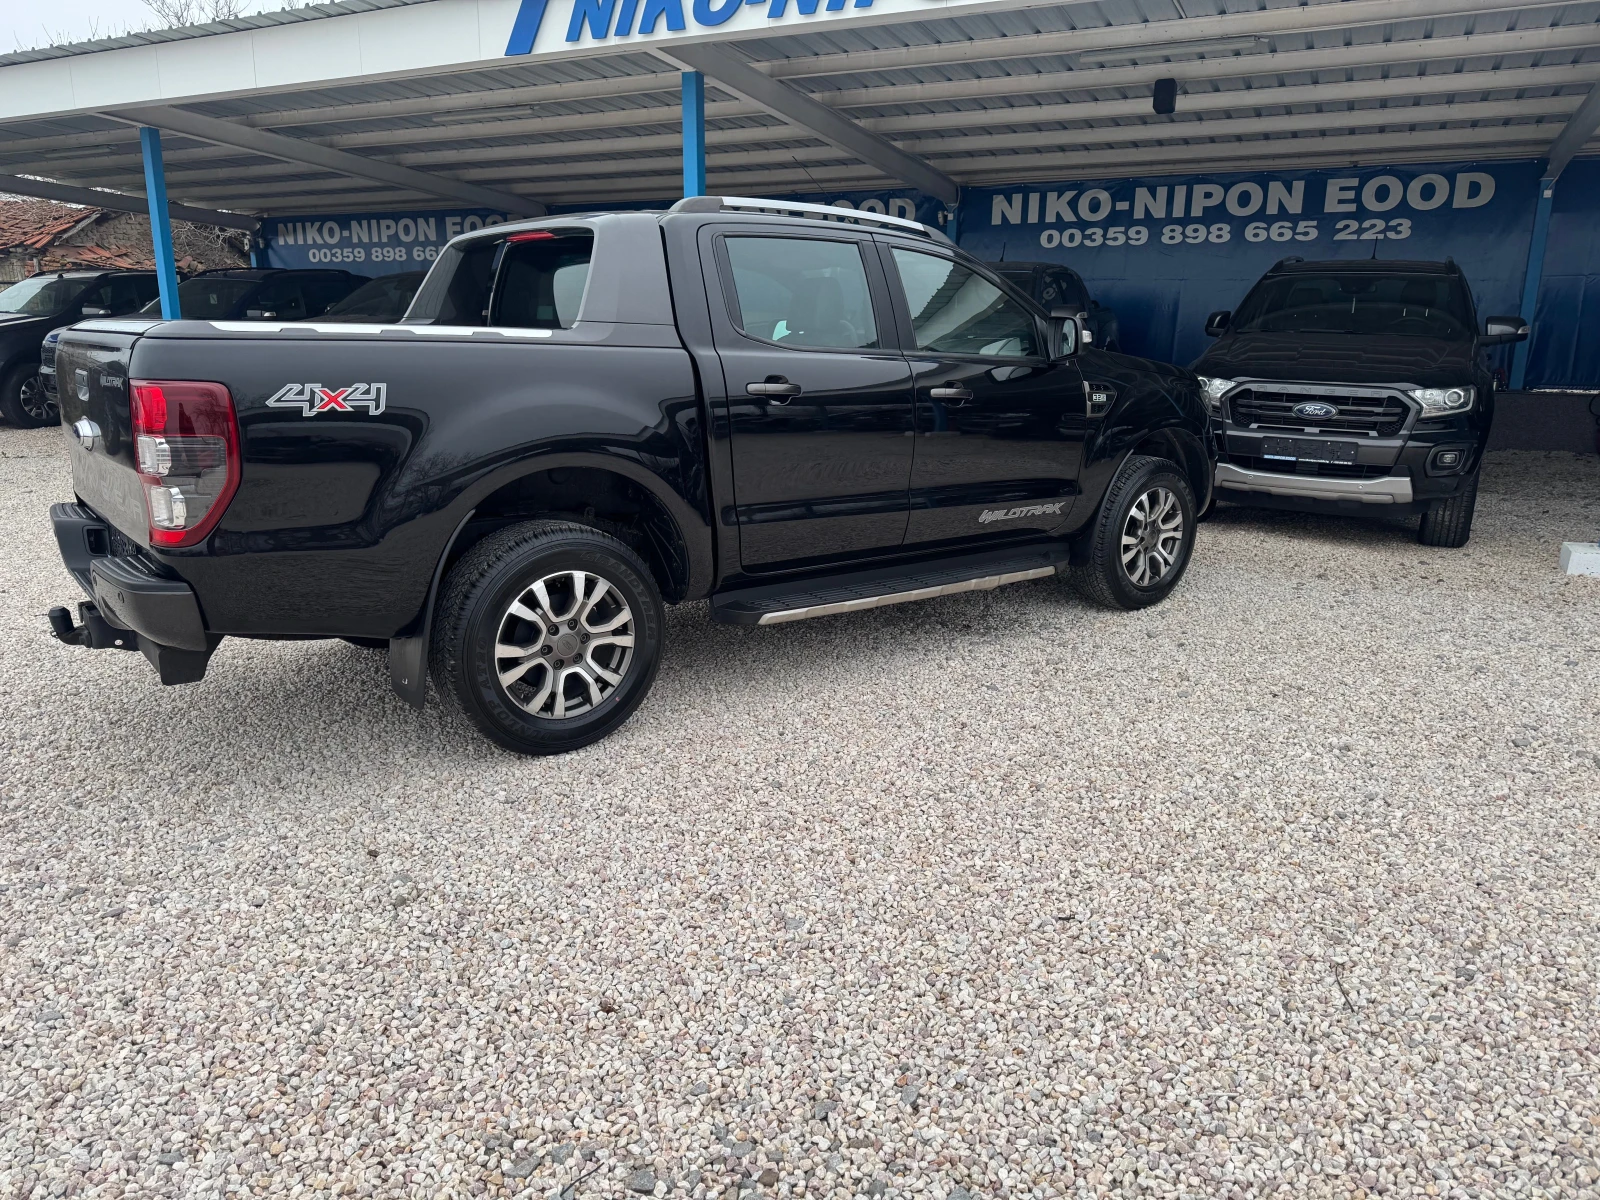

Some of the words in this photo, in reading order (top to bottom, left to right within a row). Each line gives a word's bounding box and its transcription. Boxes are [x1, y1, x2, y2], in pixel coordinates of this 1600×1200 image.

[991, 180, 1305, 226] NIKO-NIPON
[1323, 172, 1496, 214] EOOD
[278, 217, 436, 245] NIKO-NIPON
[446, 215, 522, 241] EO
[1040, 225, 1149, 248] 00359
[1160, 223, 1231, 245] 898
[1244, 220, 1318, 242] 665
[1333, 218, 1412, 241] 223
[308, 247, 366, 263] 00359
[371, 246, 407, 262] 898
[1256, 385, 1383, 397] RANGER
[979, 502, 1066, 524] WILDTRAK
